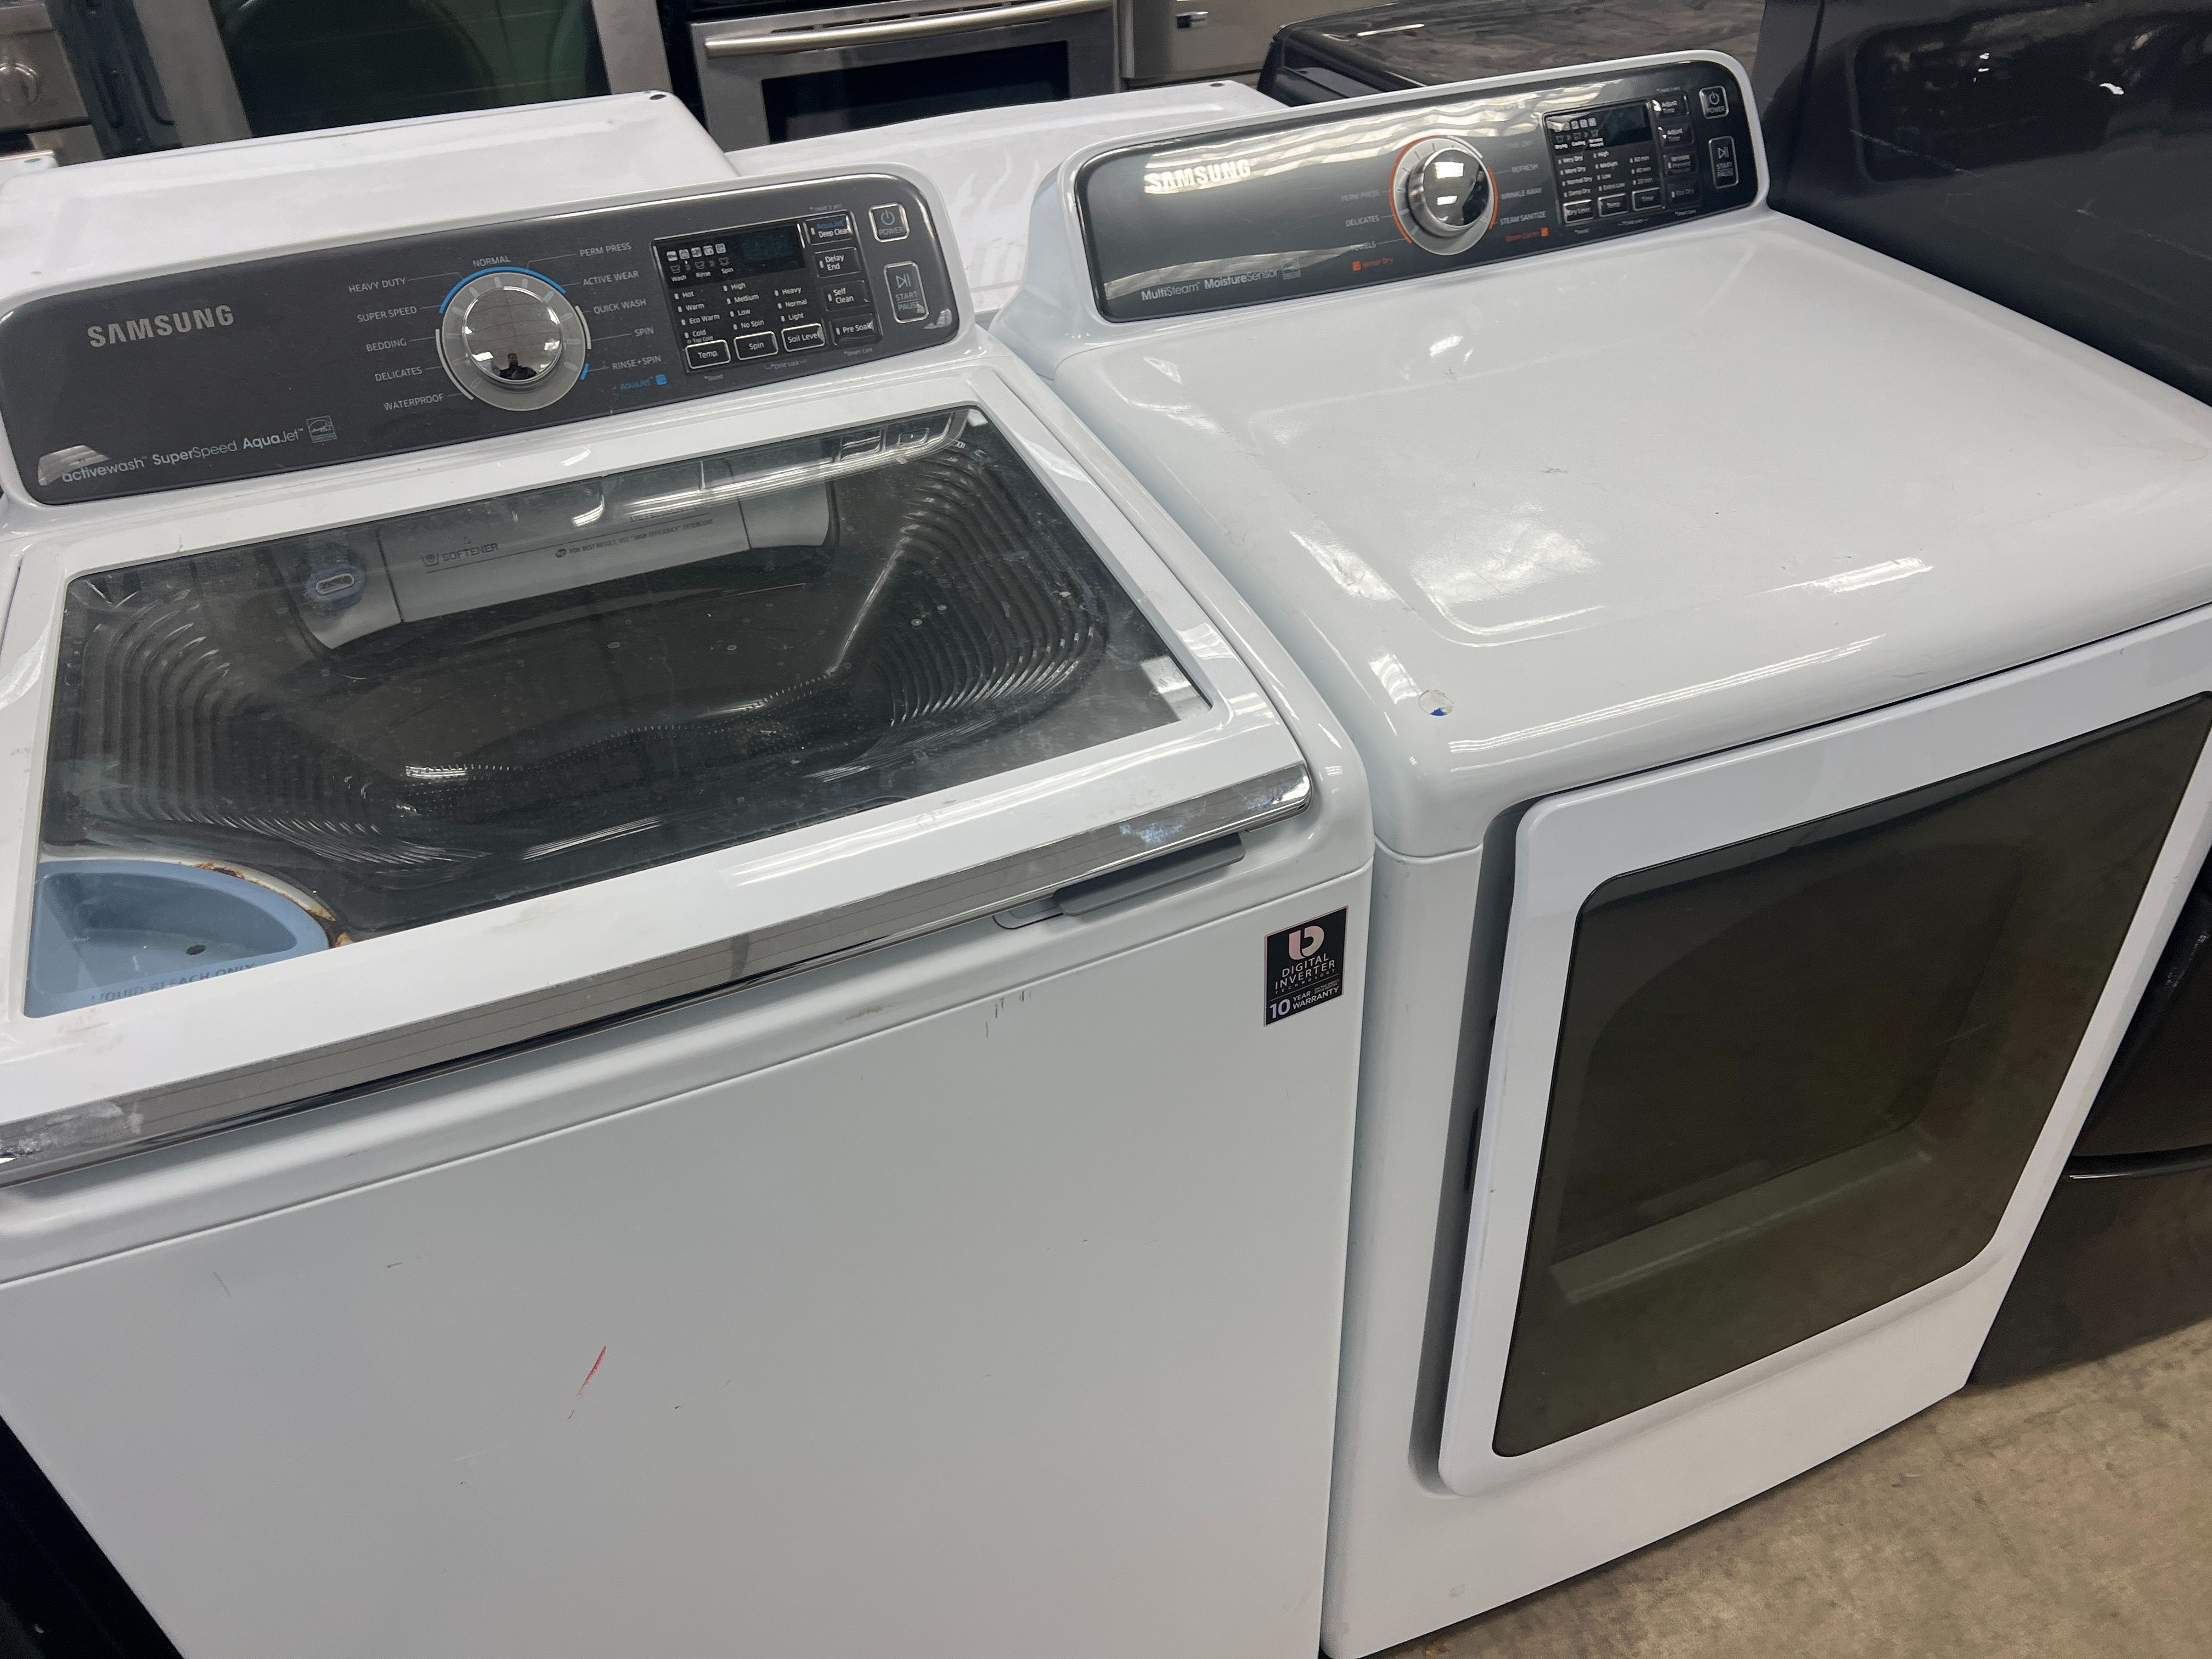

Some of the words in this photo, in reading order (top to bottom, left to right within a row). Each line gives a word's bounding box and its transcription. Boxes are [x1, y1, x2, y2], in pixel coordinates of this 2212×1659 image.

[1716, 161, 1733, 170] START
[1144, 159, 1251, 192] SAMSUNG
[1345, 215, 1380, 227] DELICATES
[1499, 215, 1520, 225] STEAM
[878, 225, 905, 236] POWER
[579, 247, 603, 257] PERM
[605, 242, 632, 253] PRESS
[472, 255, 511, 267] NORMAL
[825, 255, 844, 263] Delay
[827, 262, 841, 271] End
[583, 274, 612, 286] ACTIVE
[613, 269, 640, 281] WEAR
[1204, 268, 1279, 290] MoistureSensor
[348, 281, 379, 294] HEAVY
[382, 277, 406, 289] DUTY
[730, 282, 747, 290] High
[782, 287, 802, 295] Heavy
[833, 287, 847, 296] Self
[895, 291, 918, 301] START
[734, 294, 760, 303] Medium
[785, 298, 808, 308] Normal
[835, 295, 854, 304] Clean
[593, 303, 620, 314] QUICK
[621, 298, 646, 309] WASH
[685, 303, 705, 311] Warm
[898, 302, 921, 312] PAUSE
[357, 311, 387, 323] SUPER
[388, 306, 417, 318] SPEED
[689, 317, 701, 325] Eco
[701, 314, 721, 323] Warm
[788, 312, 804, 321] Light
[87, 304, 234, 348] SAMSUNG
[751, 319, 765, 328] Spin
[634, 326, 654, 337] SPIN
[692, 329, 707, 337] Cold
[787, 334, 801, 343] Soil
[801, 331, 820, 341] Level
[366, 338, 407, 352] BEDDING
[748, 341, 765, 351] Spin
[697, 350, 720, 359] Temp.
[612, 355, 662, 370] RINSE+SPIN
[374, 366, 422, 381] DELICATES
[383, 393, 444, 411] WATERPROOF
[152, 441, 238, 465] SuperSpeed
[442, 543, 499, 562] SOFTENER
[1282, 953, 1329, 978] DIGITAL
[1275, 960, 1335, 990] INVERTER
[1293, 985, 1339, 1009] WARRANTY
[1269, 998, 1291, 1019] 10
[1293, 991, 1311, 1002] YEAR
